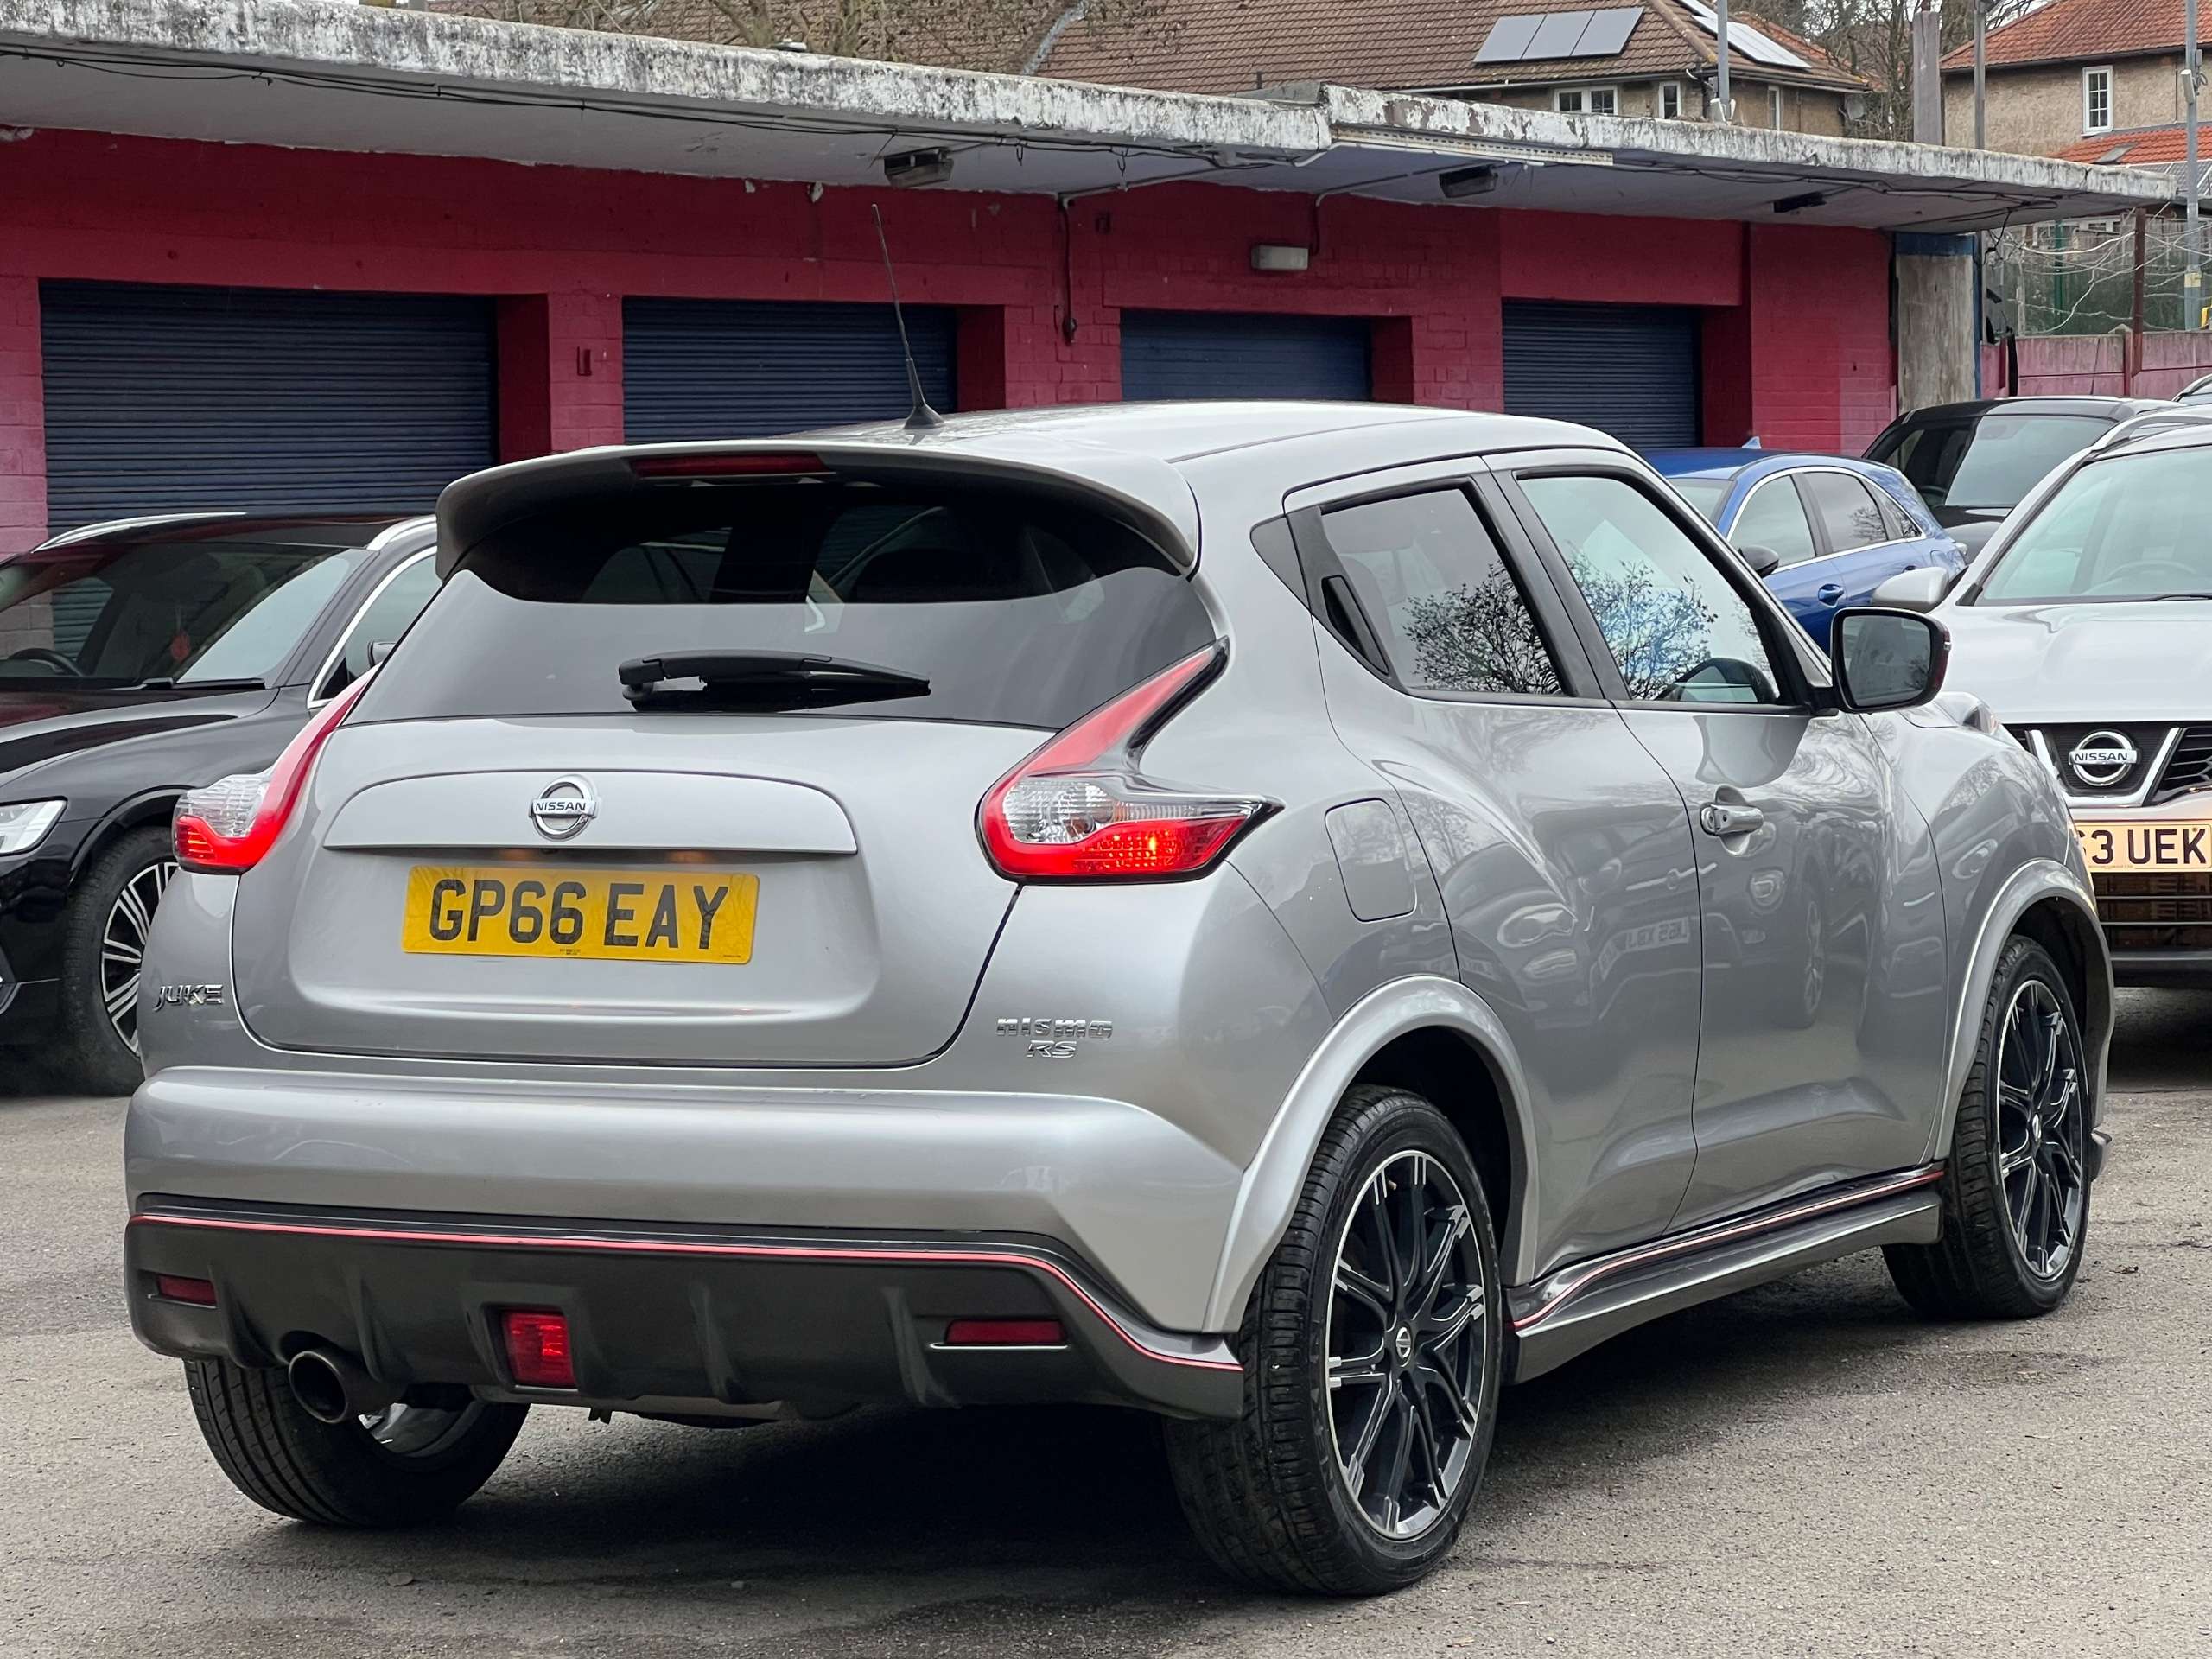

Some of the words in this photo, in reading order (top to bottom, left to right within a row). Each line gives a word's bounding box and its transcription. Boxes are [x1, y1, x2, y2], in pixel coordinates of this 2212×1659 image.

[2075, 752, 2128, 761] NISSAN
[535, 802, 586, 811] NISSAN
[2127, 829, 2207, 865] UEK
[429, 879, 587, 945] GP66
[603, 882, 729, 950] EAY
[153, 984, 225, 1013] JUKE
[1026, 1039, 1077, 1059] RS
